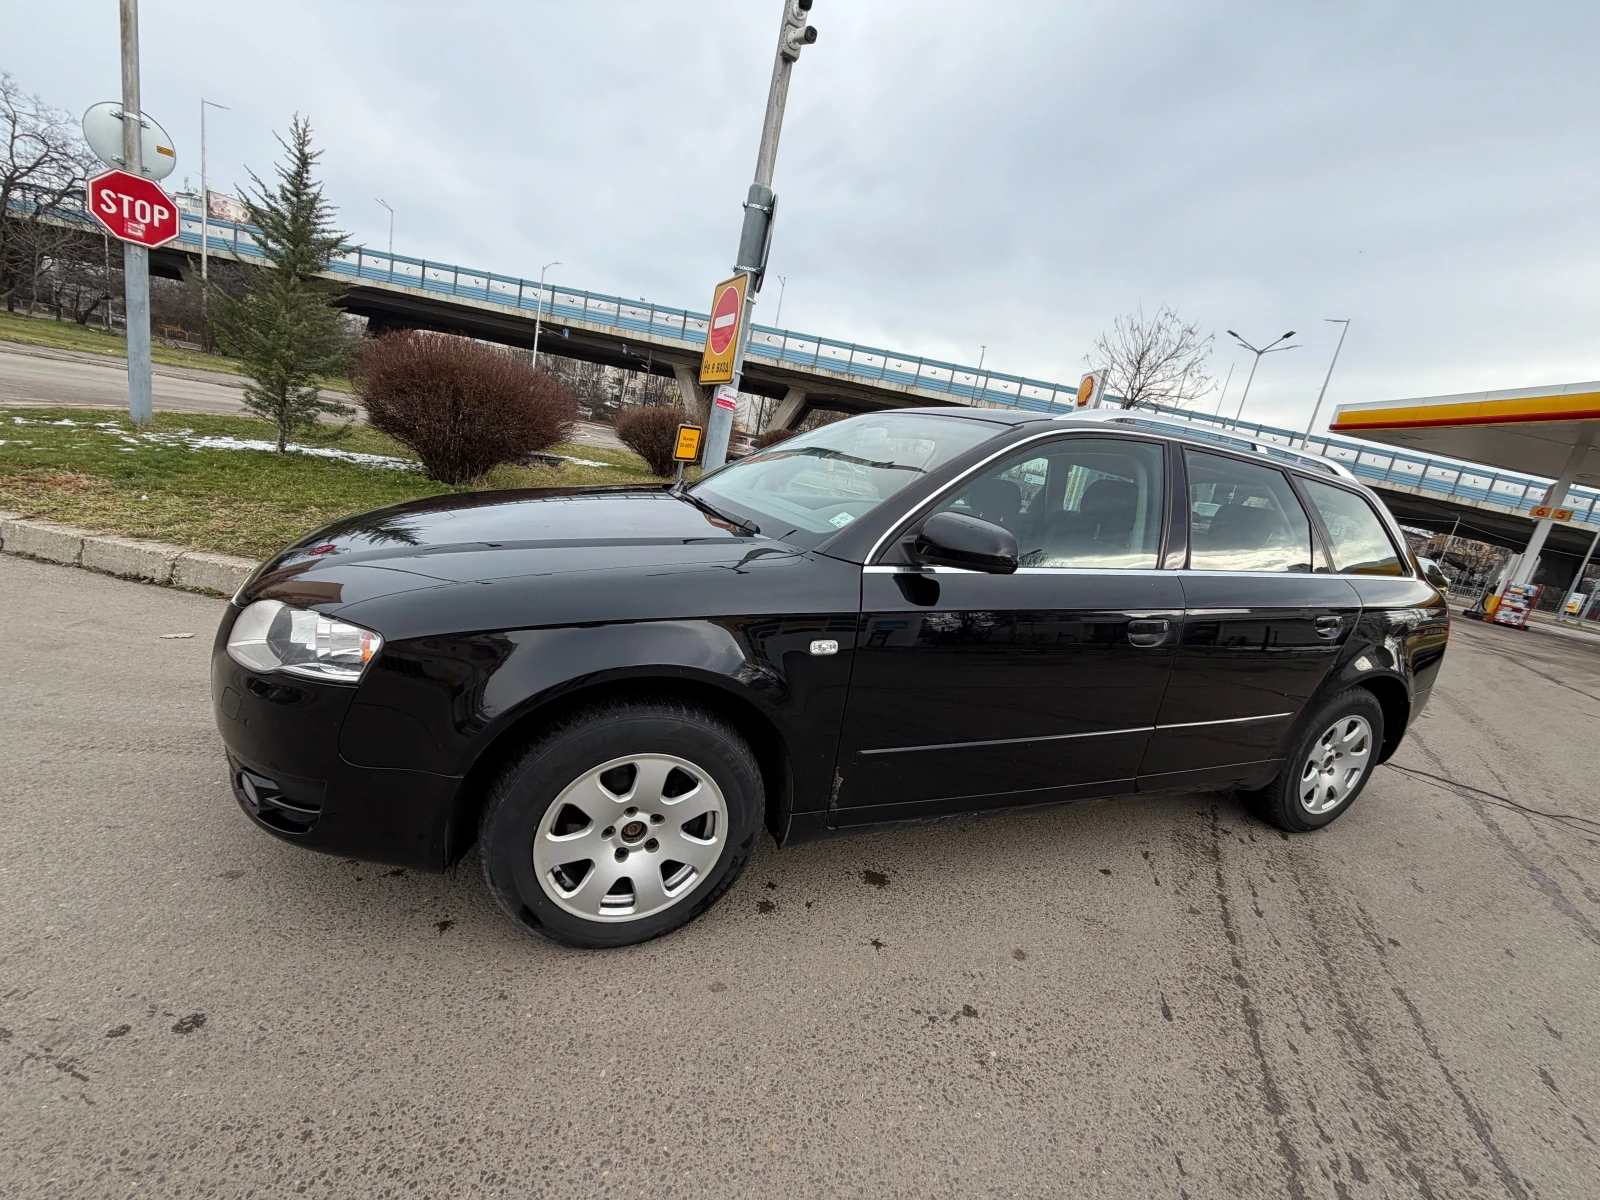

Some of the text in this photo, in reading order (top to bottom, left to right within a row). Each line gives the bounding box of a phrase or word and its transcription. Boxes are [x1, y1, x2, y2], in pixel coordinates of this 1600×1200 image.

[100, 189, 169, 227] STOP
[703, 359, 710, 375] Не
[716, 357, 732, 375] вход!
[1536, 507, 1545, 516] 6
[1556, 510, 1567, 519] 5
